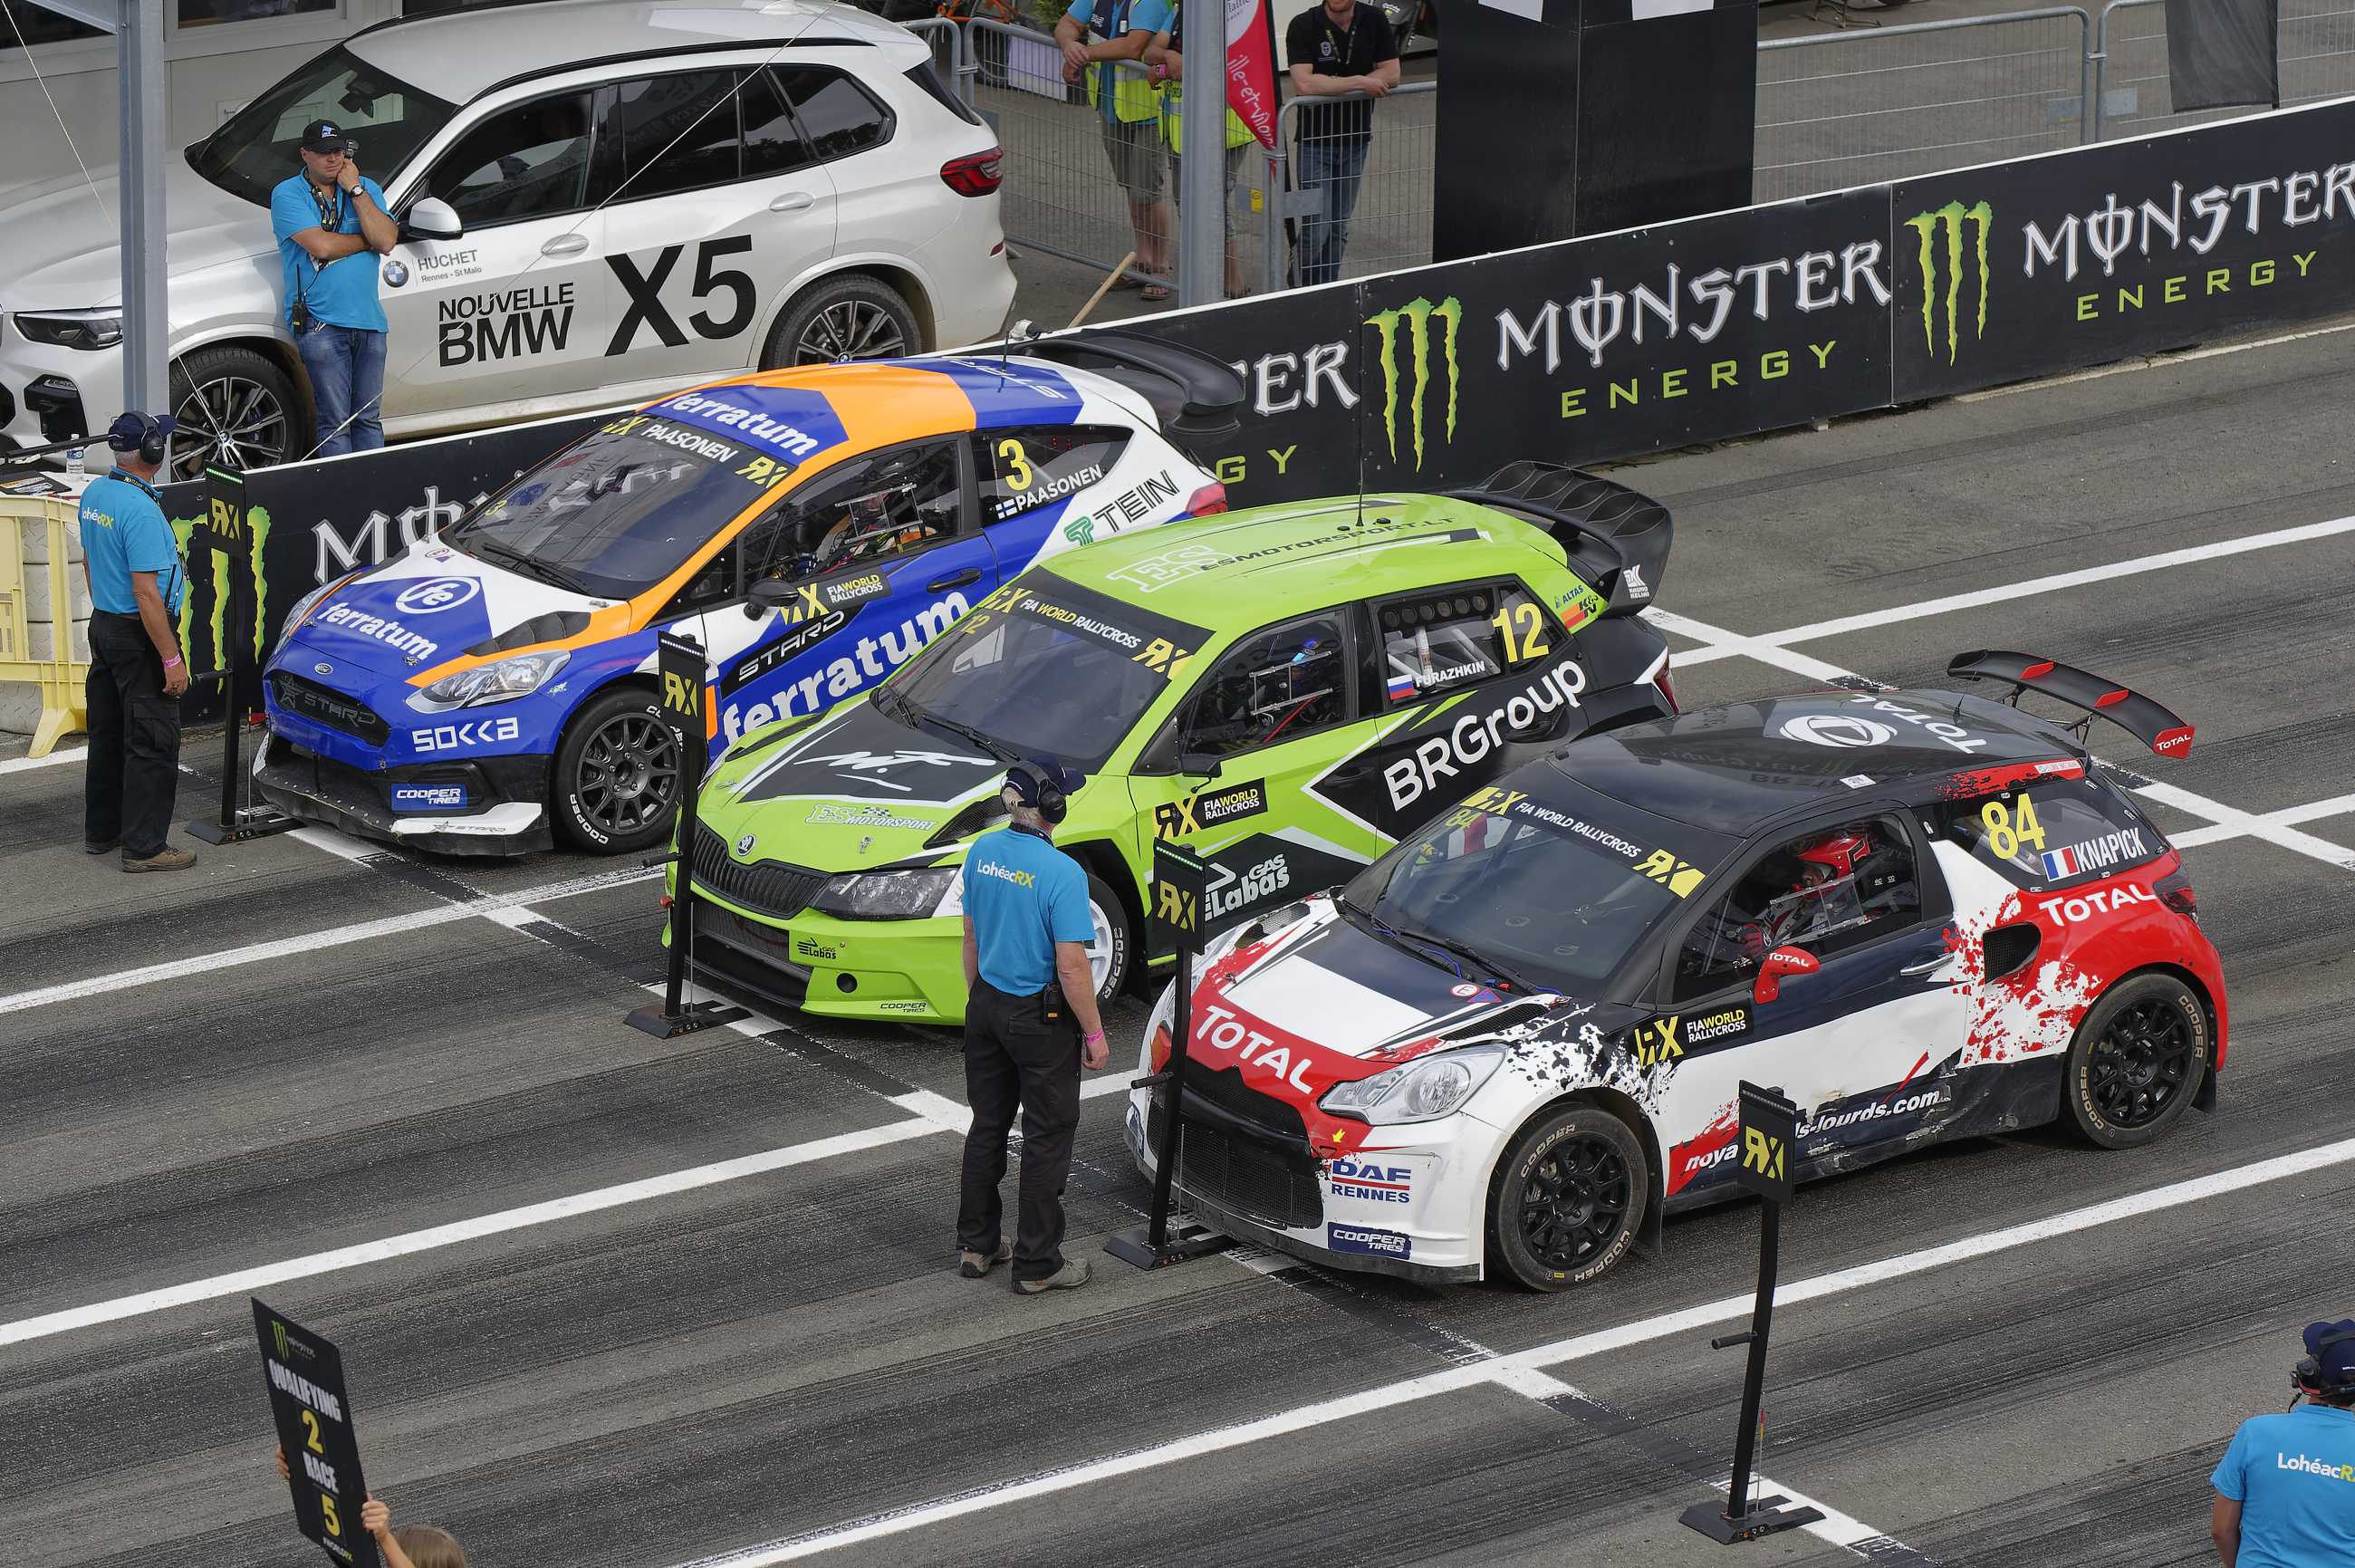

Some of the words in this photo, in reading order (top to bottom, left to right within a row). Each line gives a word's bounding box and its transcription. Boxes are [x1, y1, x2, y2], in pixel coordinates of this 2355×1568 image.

[2023, 160, 2355, 282] MONSTER
[418, 249, 478, 271] HUCHET
[421, 272, 448, 283] Rennes
[455, 268, 464, 277] St
[465, 265, 482, 275] Malo
[438, 282, 574, 321] NOUVELLE
[604, 234, 756, 356] X5
[1496, 238, 1892, 374] MONSTER
[2077, 251, 2316, 321] ENERGY
[439, 305, 573, 367] BMW
[1562, 340, 1836, 418] ENERGY
[640, 424, 738, 464] PAASONEN
[660, 392, 819, 456] ferratum
[998, 438, 1033, 491] 3
[1015, 463, 1104, 511] PAASONEN
[1092, 469, 1180, 533] TEIN
[830, 582, 883, 603] RALLYCROSS
[1106, 544, 1239, 593] ES
[1562, 584, 1584, 604] ALTAS
[317, 601, 438, 660] ferratum
[739, 610, 845, 681] STARD
[1020, 599, 1039, 612] FIA
[1036, 602, 1078, 624] WORLD
[1072, 616, 1142, 649] RALLYCROSS
[1493, 602, 1550, 663] 12
[723, 592, 970, 746] ferratum
[1415, 660, 1485, 688] FURAZHKIN
[1383, 660, 1586, 812] BRGroup
[1850, 693, 1987, 754] TOTAL
[2157, 733, 2192, 751] TOTAL
[396, 788, 461, 799] COOPER
[1205, 798, 1260, 821] RALLYCROSS
[569, 794, 610, 844] COOPER
[848, 816, 937, 831] MOTORSPORT
[1514, 802, 1534, 815] FIA
[1534, 807, 1573, 828] WORLD
[1571, 818, 1642, 859] RALLYCROSS
[1980, 792, 2046, 861] 84
[976, 859, 1036, 889] LohéacRX
[1249, 853, 1285, 880] GAS
[2074, 827, 2148, 872] KNAPICK
[1212, 866, 1290, 919] Labas
[2037, 884, 2156, 928] TOTAL
[809, 948, 837, 959] Labas
[1768, 952, 1811, 967] TOTAL
[1196, 1005, 1319, 1095] TOTAL
[1687, 1021, 1746, 1043] RALLYCROSS
[2177, 995, 2205, 1059] COOPER
[2080, 1066, 2106, 1130] COOPER
[1332, 1160, 1411, 1181] DAF
[1520, 1123, 1576, 1178] COOPER
[1331, 1183, 1410, 1204] RENNES
[1333, 1229, 1406, 1246] COOPER
[1367, 1242, 1404, 1252] TIRES
[1574, 1230, 1630, 1282] COOPER
[268, 1358, 342, 1423] QUALIFYING
[302, 1409, 324, 1455] 2
[303, 1451, 340, 1494] RACE
[321, 1493, 341, 1537] 5
